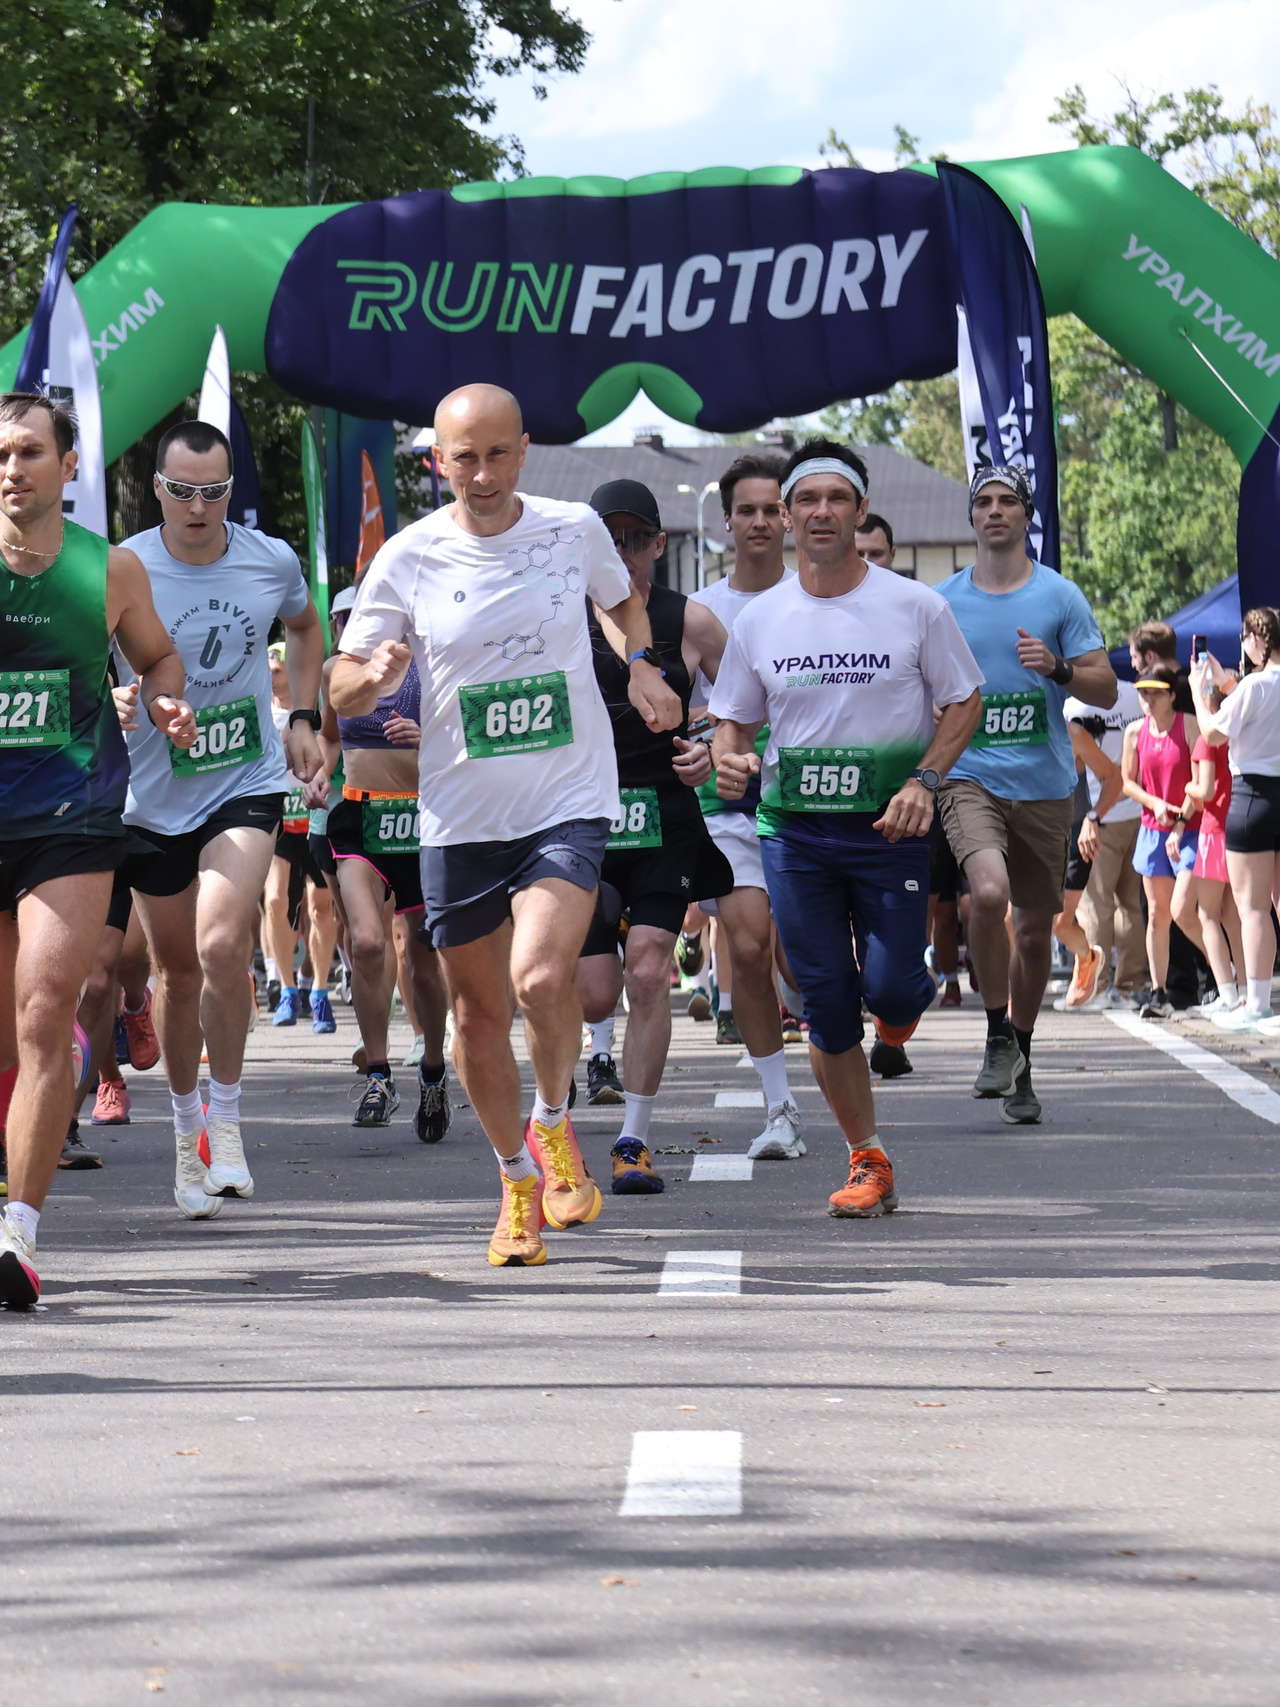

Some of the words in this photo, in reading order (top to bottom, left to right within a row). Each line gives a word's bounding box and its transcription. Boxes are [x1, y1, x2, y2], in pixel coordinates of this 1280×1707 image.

[1121, 232, 1280, 378] УРАЛХИМ
[91, 286, 166, 368] ХИМ
[208, 598, 256, 657] BIVIUM
[773, 652, 890, 675] УРАЛХИМ
[486, 694, 553, 738] 692
[985, 705, 1035, 734] 562
[189, 717, 246, 759] 502
[799, 765, 860, 796] 559
